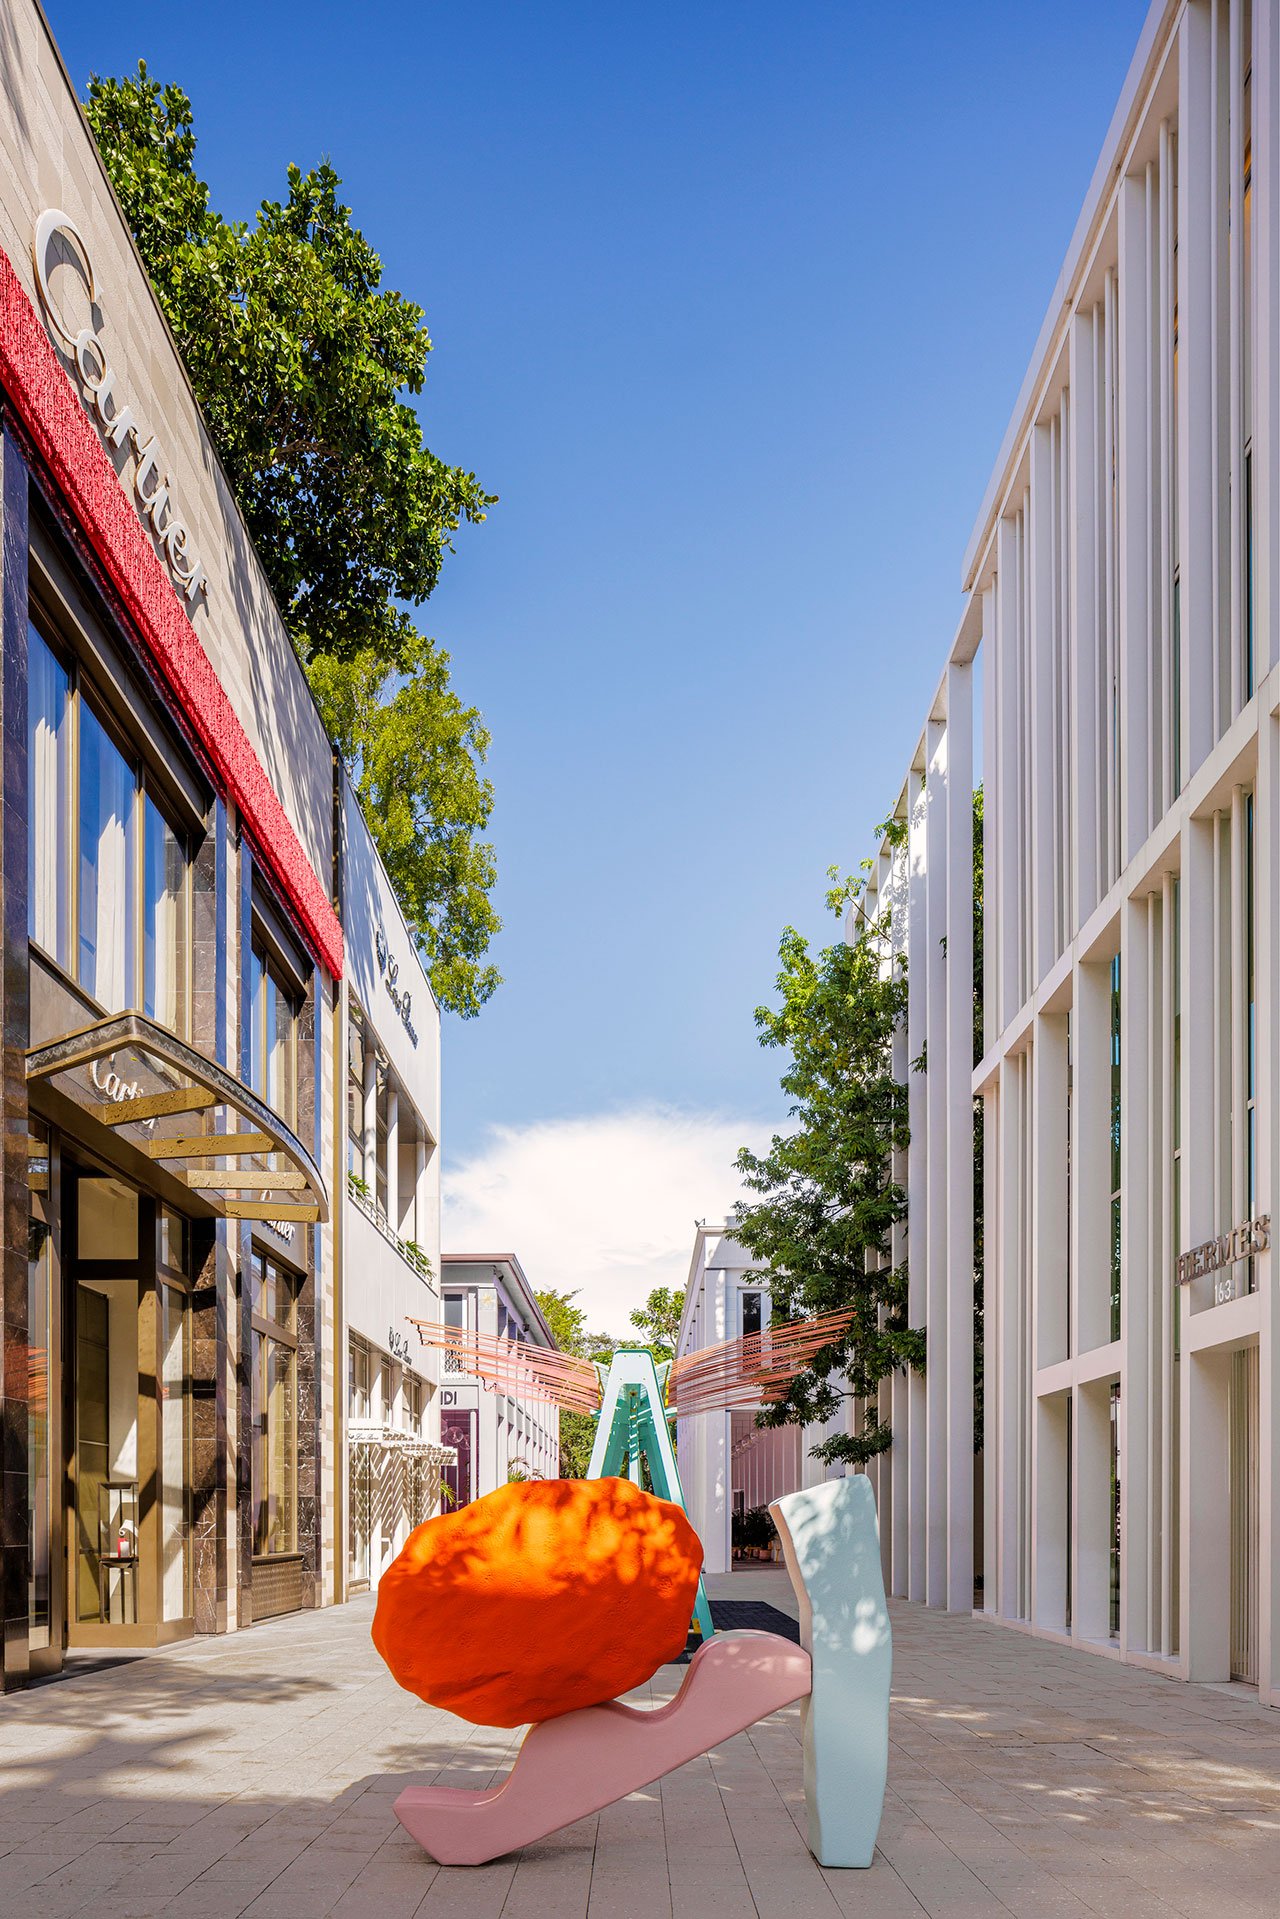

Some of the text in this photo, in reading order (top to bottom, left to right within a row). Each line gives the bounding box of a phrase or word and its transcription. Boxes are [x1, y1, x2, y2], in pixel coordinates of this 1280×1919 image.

[32, 208, 208, 600] Cartier
[1174, 1215, 1270, 1286] HERMÈS
[1215, 1279, 1232, 1304] 163
